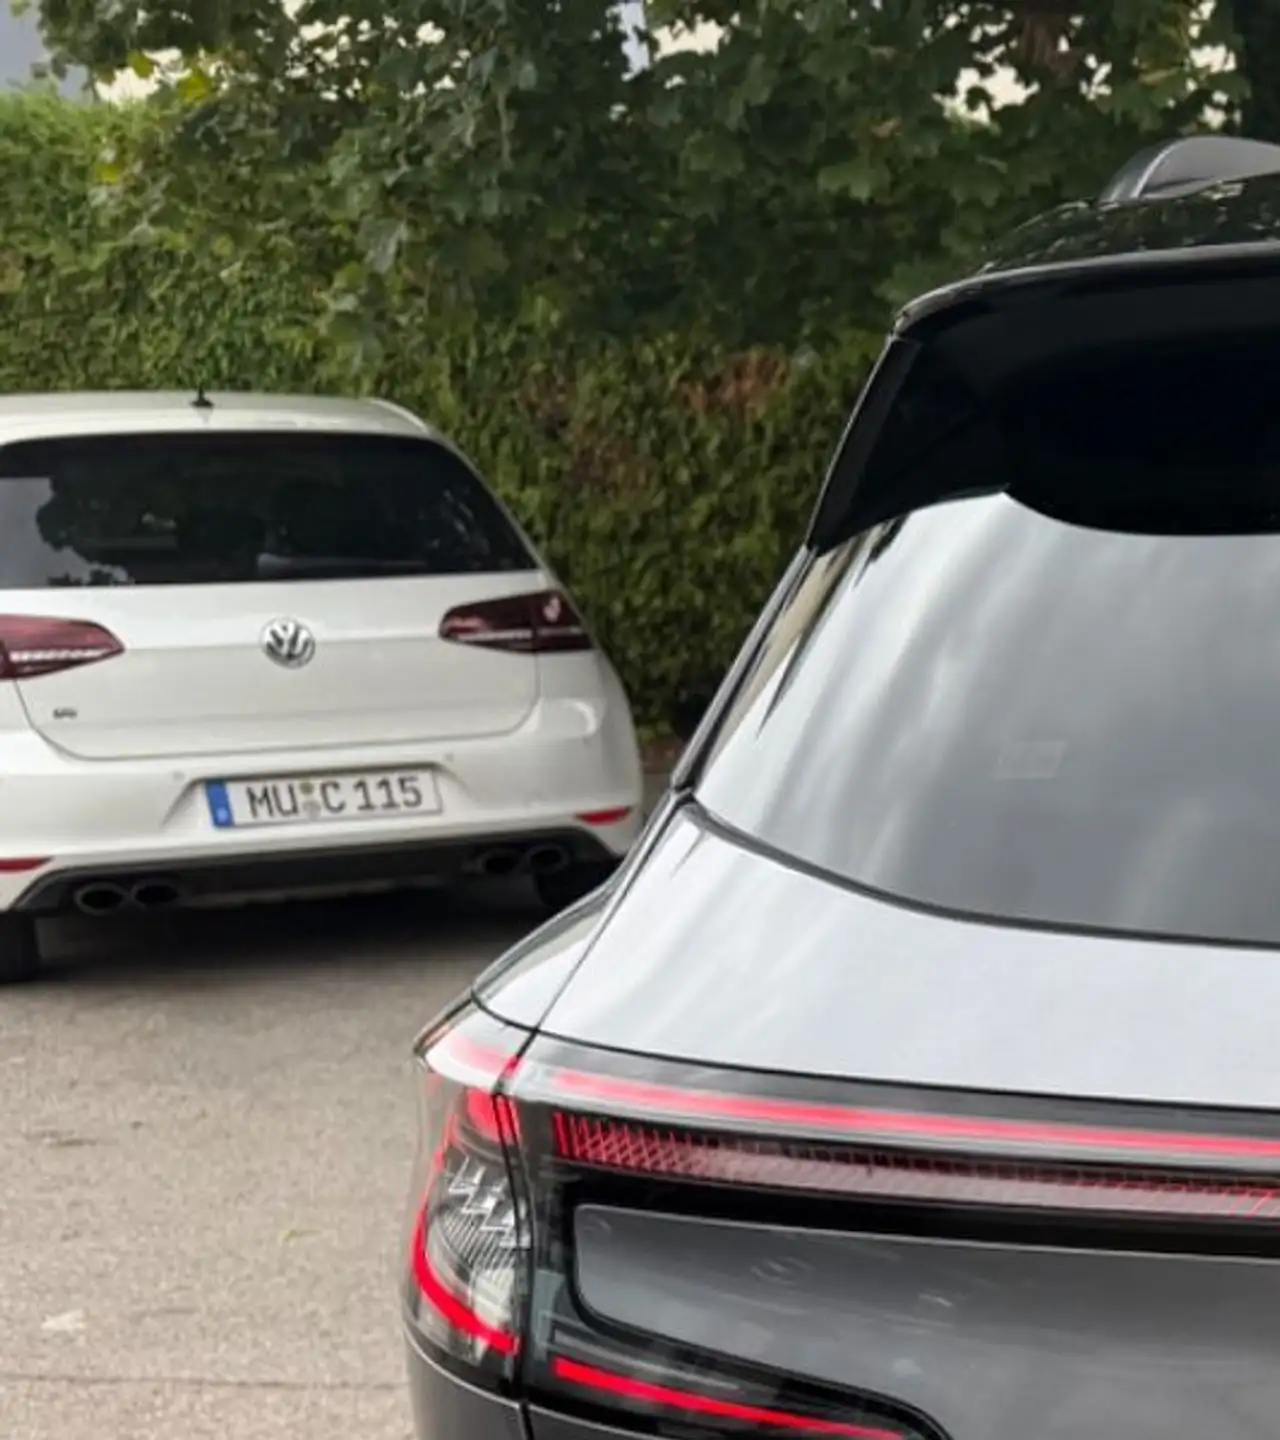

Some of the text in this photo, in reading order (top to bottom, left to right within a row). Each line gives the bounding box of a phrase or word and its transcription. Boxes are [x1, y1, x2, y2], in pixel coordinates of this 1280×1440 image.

[245, 776, 423, 819] MU C 115
